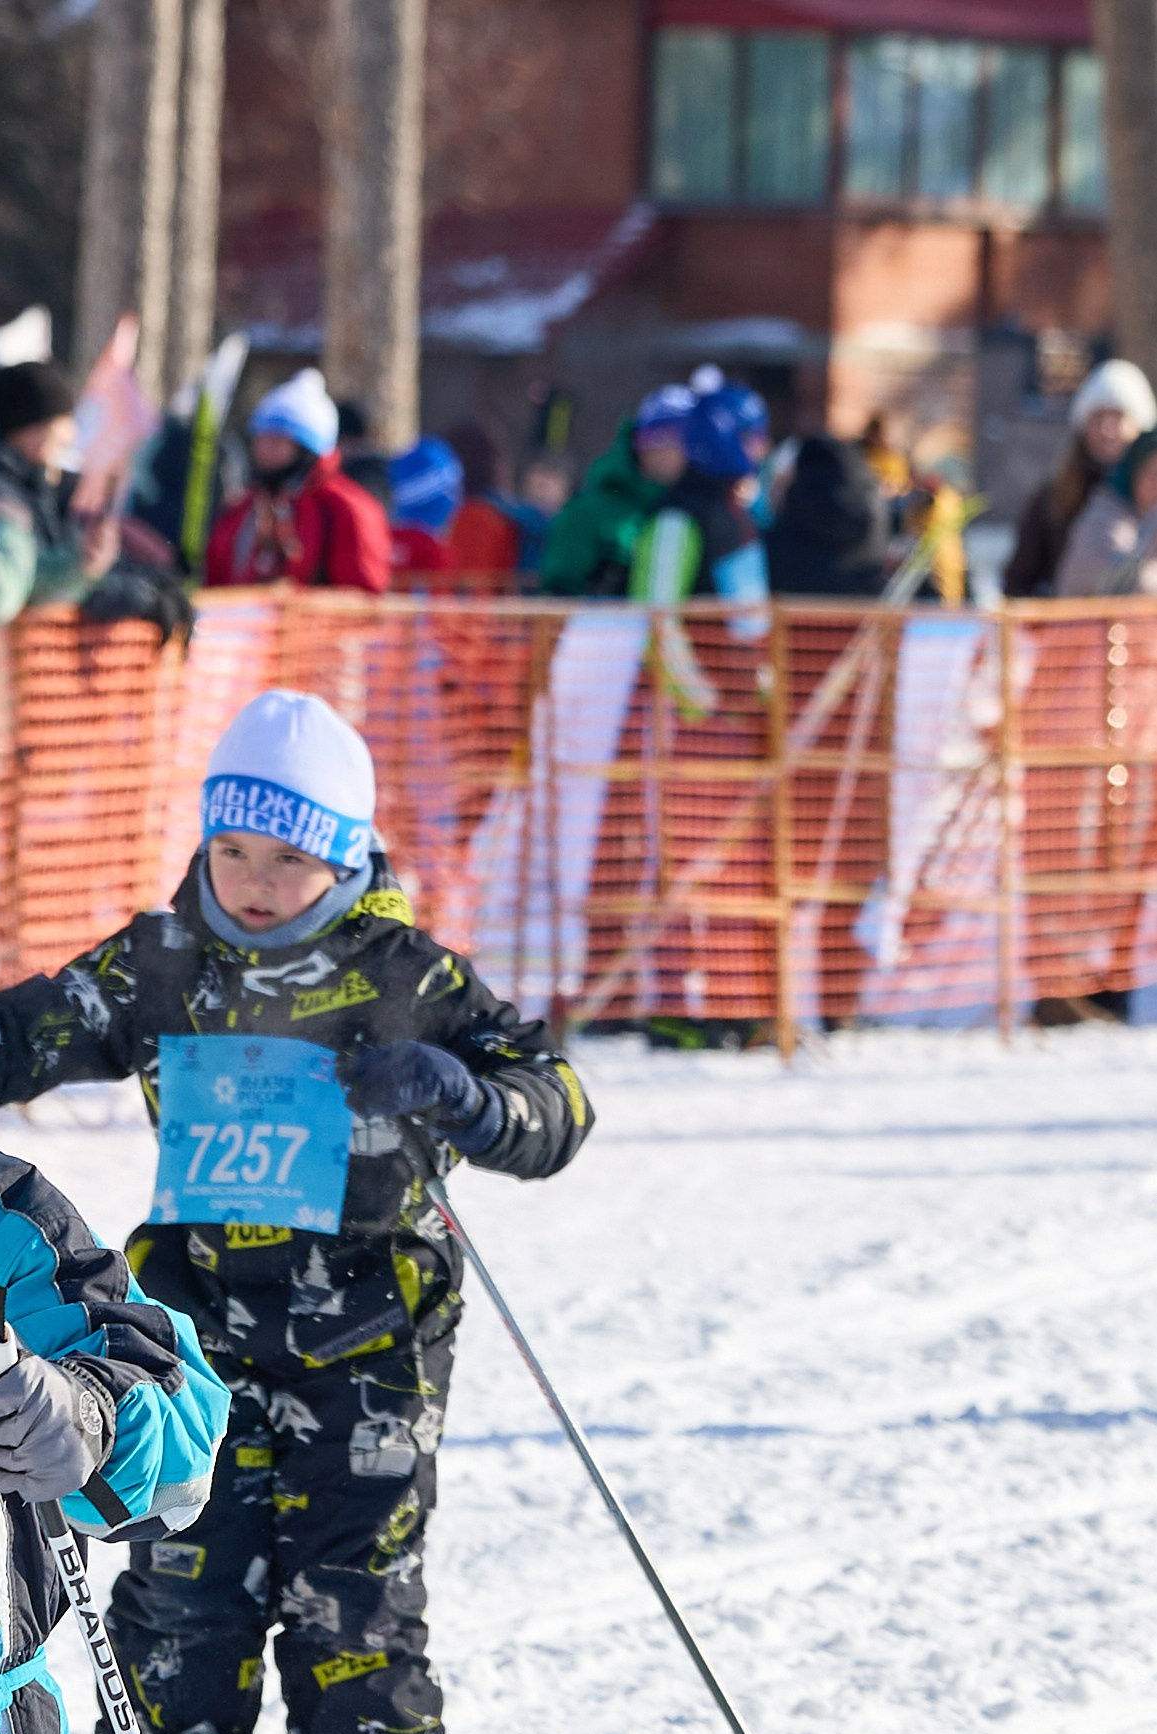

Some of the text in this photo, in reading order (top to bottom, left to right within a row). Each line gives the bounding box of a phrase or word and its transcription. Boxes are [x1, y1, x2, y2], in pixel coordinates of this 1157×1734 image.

[211, 780, 339, 841] ЛЫЖНЯ
[186, 1123, 311, 1184] 7257
[57, 1547, 136, 1732] BRADOS
